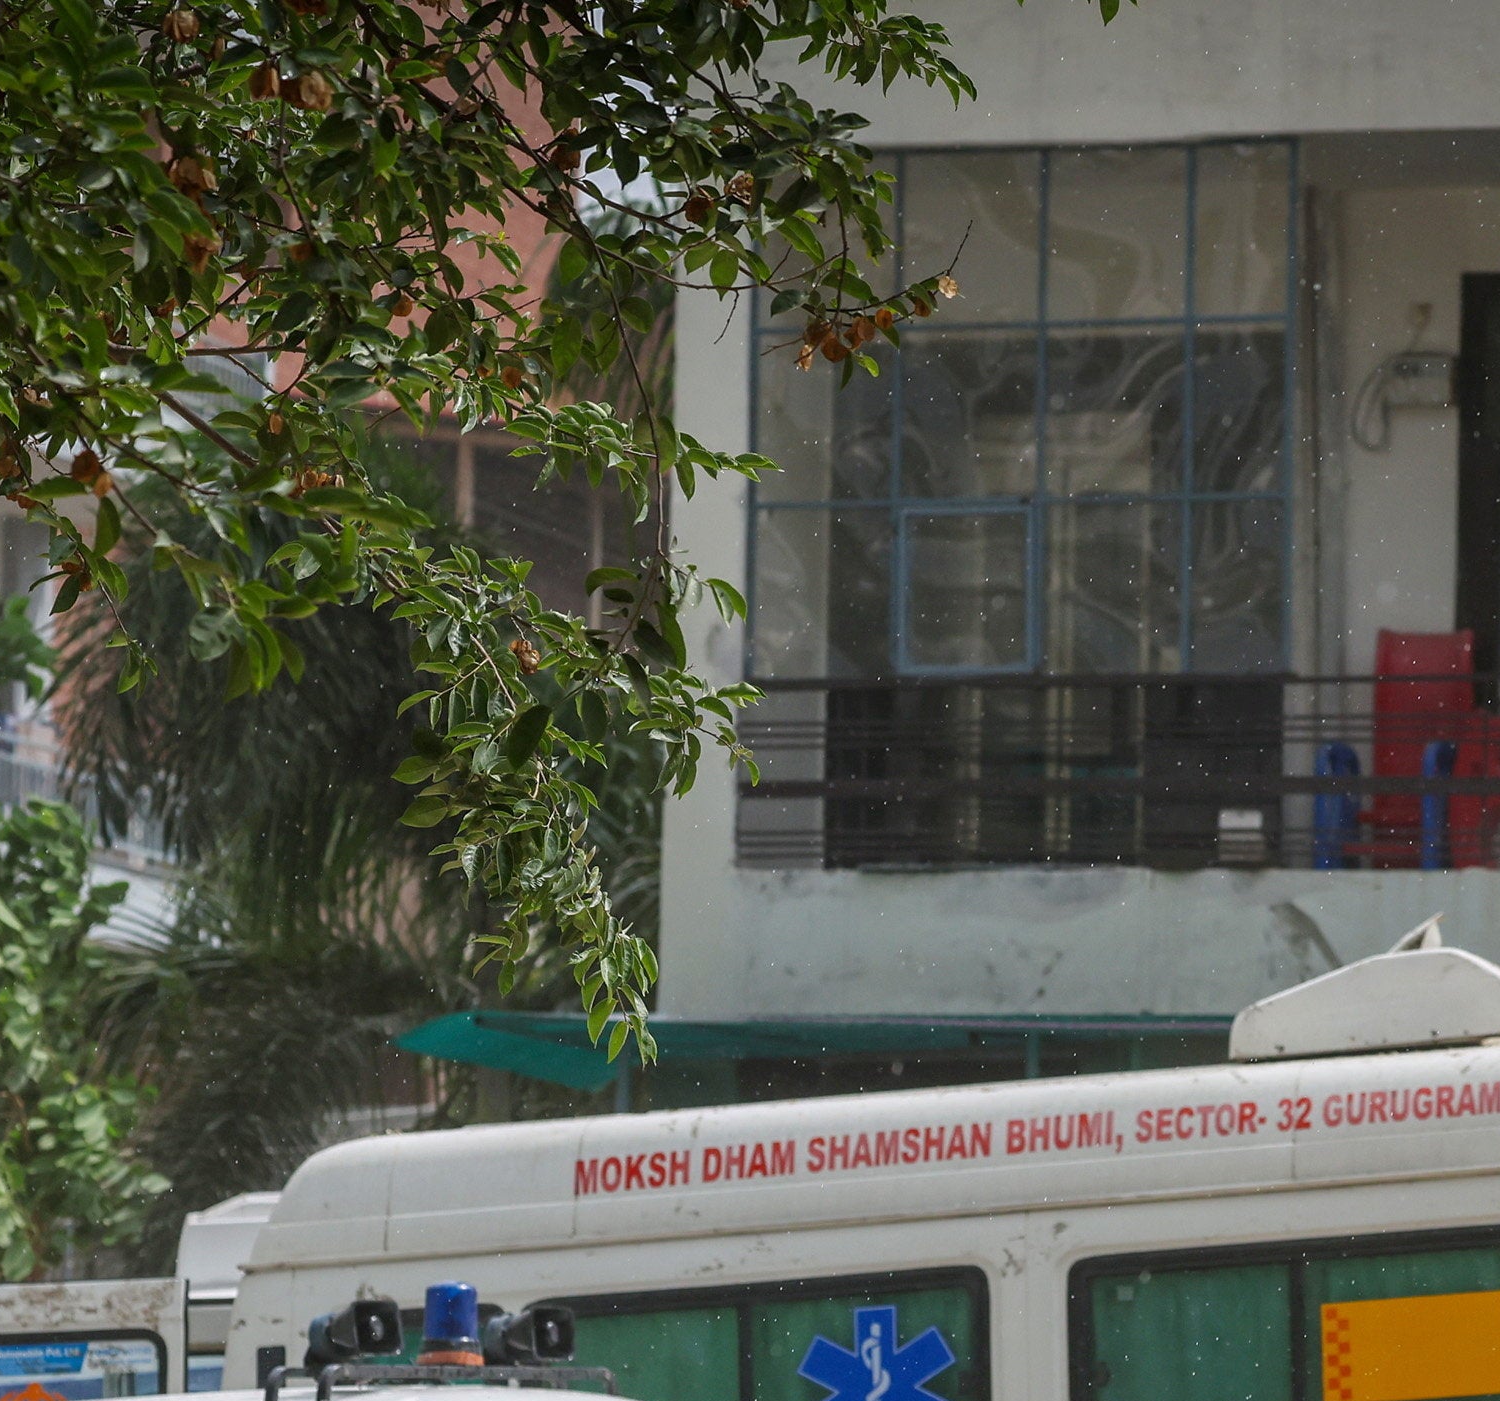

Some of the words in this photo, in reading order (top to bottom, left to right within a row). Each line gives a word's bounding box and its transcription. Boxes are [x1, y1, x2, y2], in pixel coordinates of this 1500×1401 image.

[573, 1150, 690, 1197] MOKSH
[702, 1139, 796, 1183] DHAM
[806, 1122, 991, 1173] SHAMSHAN
[1006, 1111, 1125, 1156] BHUMI,
[1135, 1101, 1267, 1144] SECTOR-
[1277, 1097, 1312, 1133] 32
